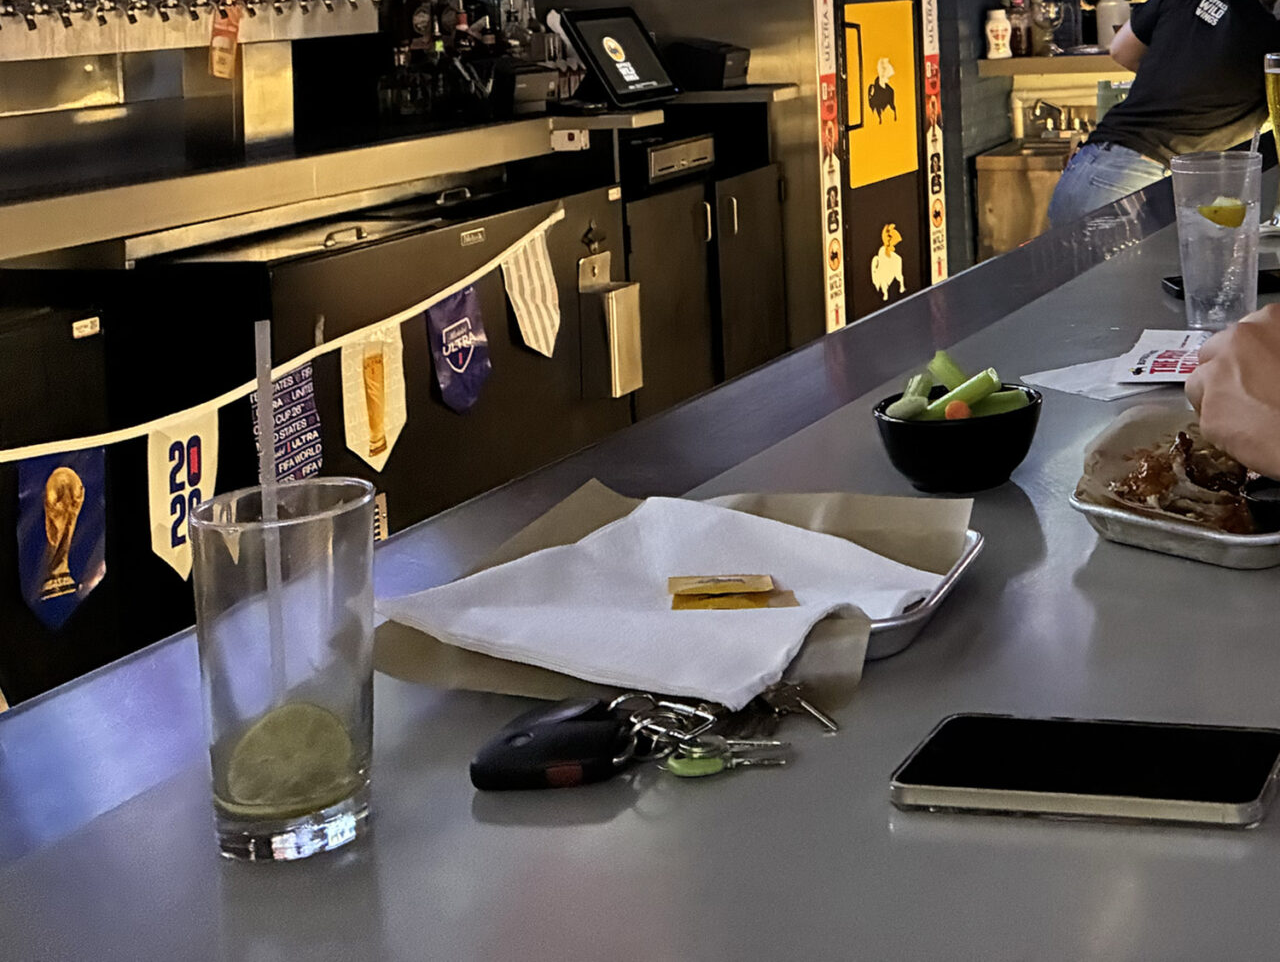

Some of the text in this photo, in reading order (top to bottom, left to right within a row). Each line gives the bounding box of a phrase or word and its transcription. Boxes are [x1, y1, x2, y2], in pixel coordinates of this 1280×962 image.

[442, 331, 477, 356] ULTRA
[279, 418, 308, 440] STATES
[291, 430, 319, 449] ULTRA
[168, 434, 202, 495] 20
[278, 458, 296, 474] FIFA
[294, 443, 323, 464] WORLD
